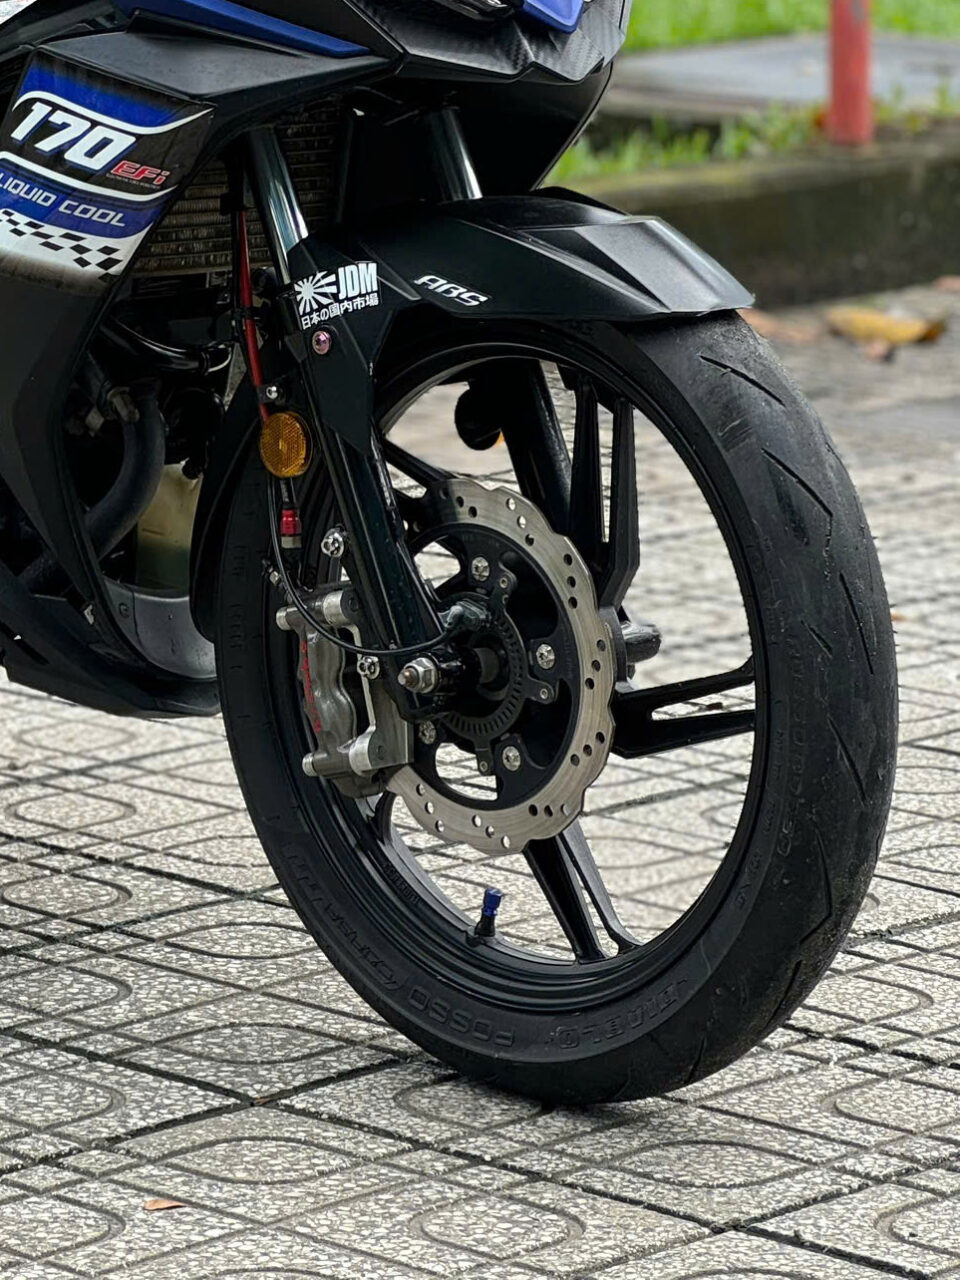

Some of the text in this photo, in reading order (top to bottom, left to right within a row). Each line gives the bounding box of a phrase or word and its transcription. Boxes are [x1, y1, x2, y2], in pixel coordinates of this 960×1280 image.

[10, 103, 137, 171] 170
[110, 160, 171, 185] EFi
[58, 200, 127, 228] COOL
[337, 261, 378, 301] JDM
[413, 275, 490, 307] ABS
[301, 293, 380, 330] 日本の国内市場
